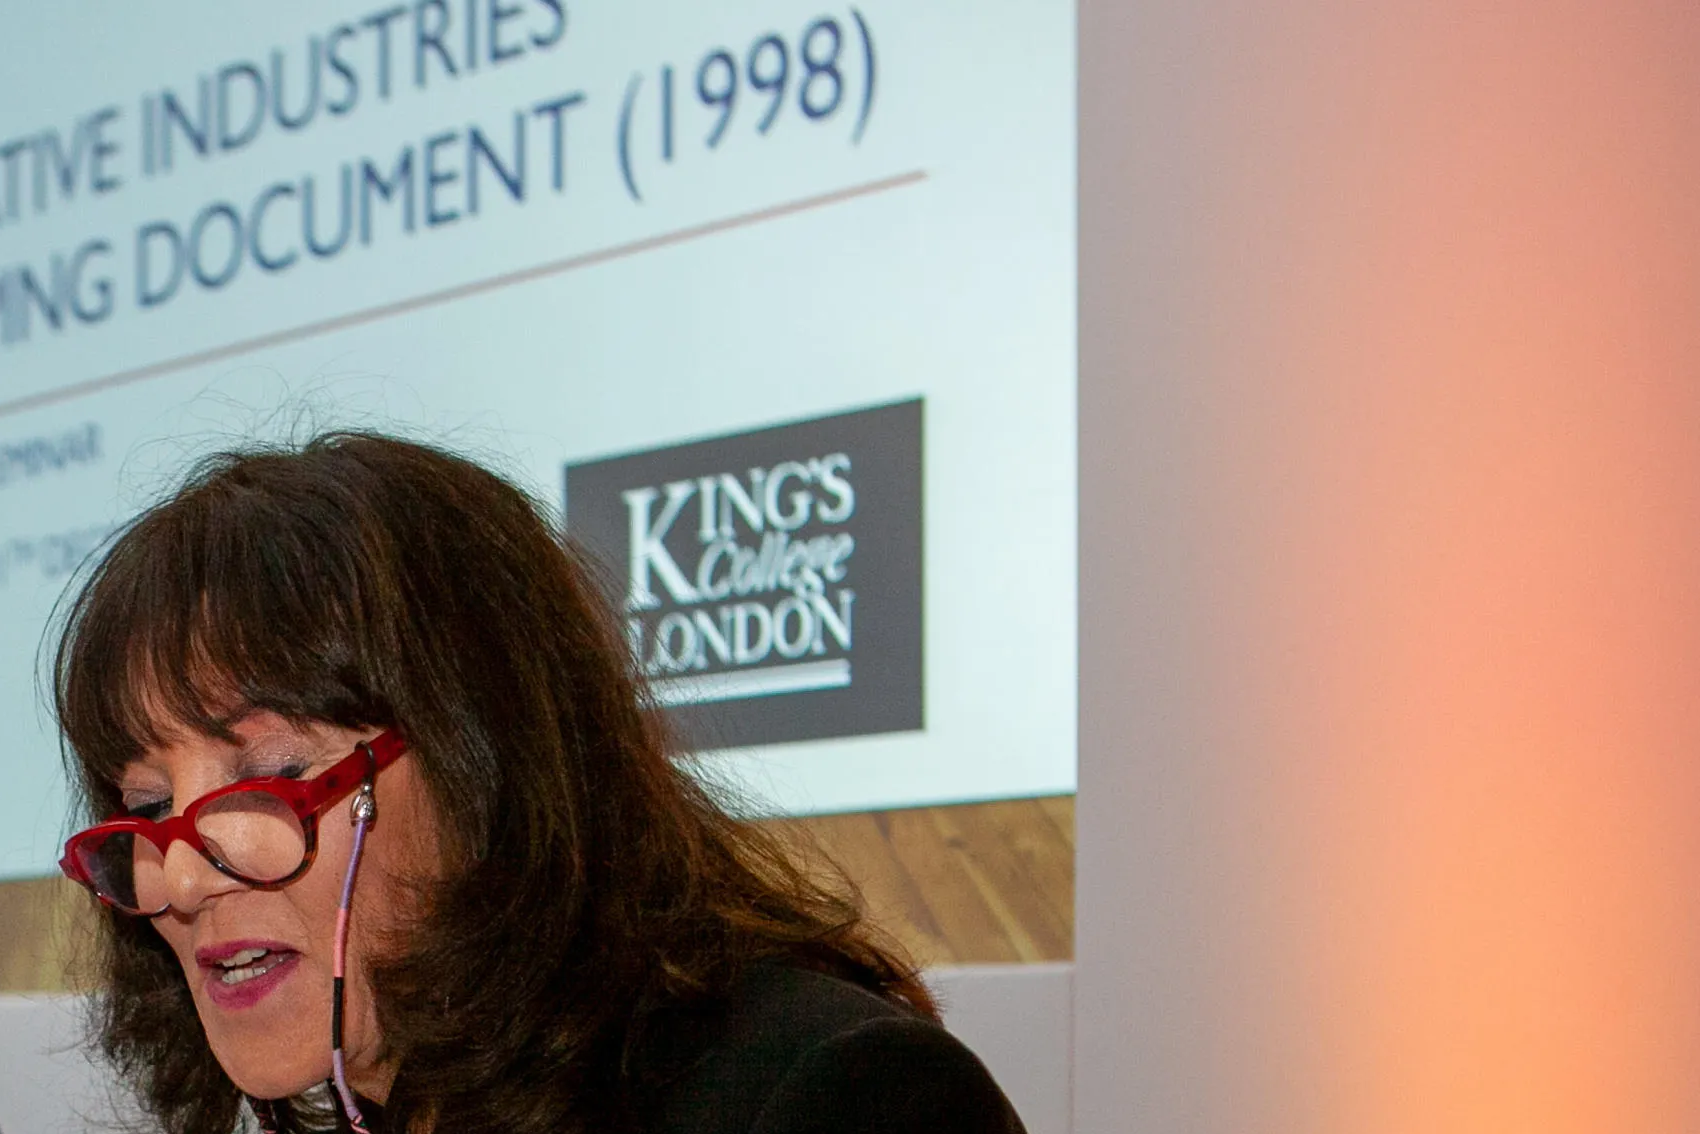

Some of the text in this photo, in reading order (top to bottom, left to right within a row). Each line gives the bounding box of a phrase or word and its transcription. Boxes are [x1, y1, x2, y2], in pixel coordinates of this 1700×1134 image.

[133, 91, 588, 307] DOCUMENT
[616, 4, 878, 202] (1998)
[140, 0, 570, 176] INDUSTRIES
[621, 453, 855, 610] KING'S
[625, 588, 856, 676] LONDON
